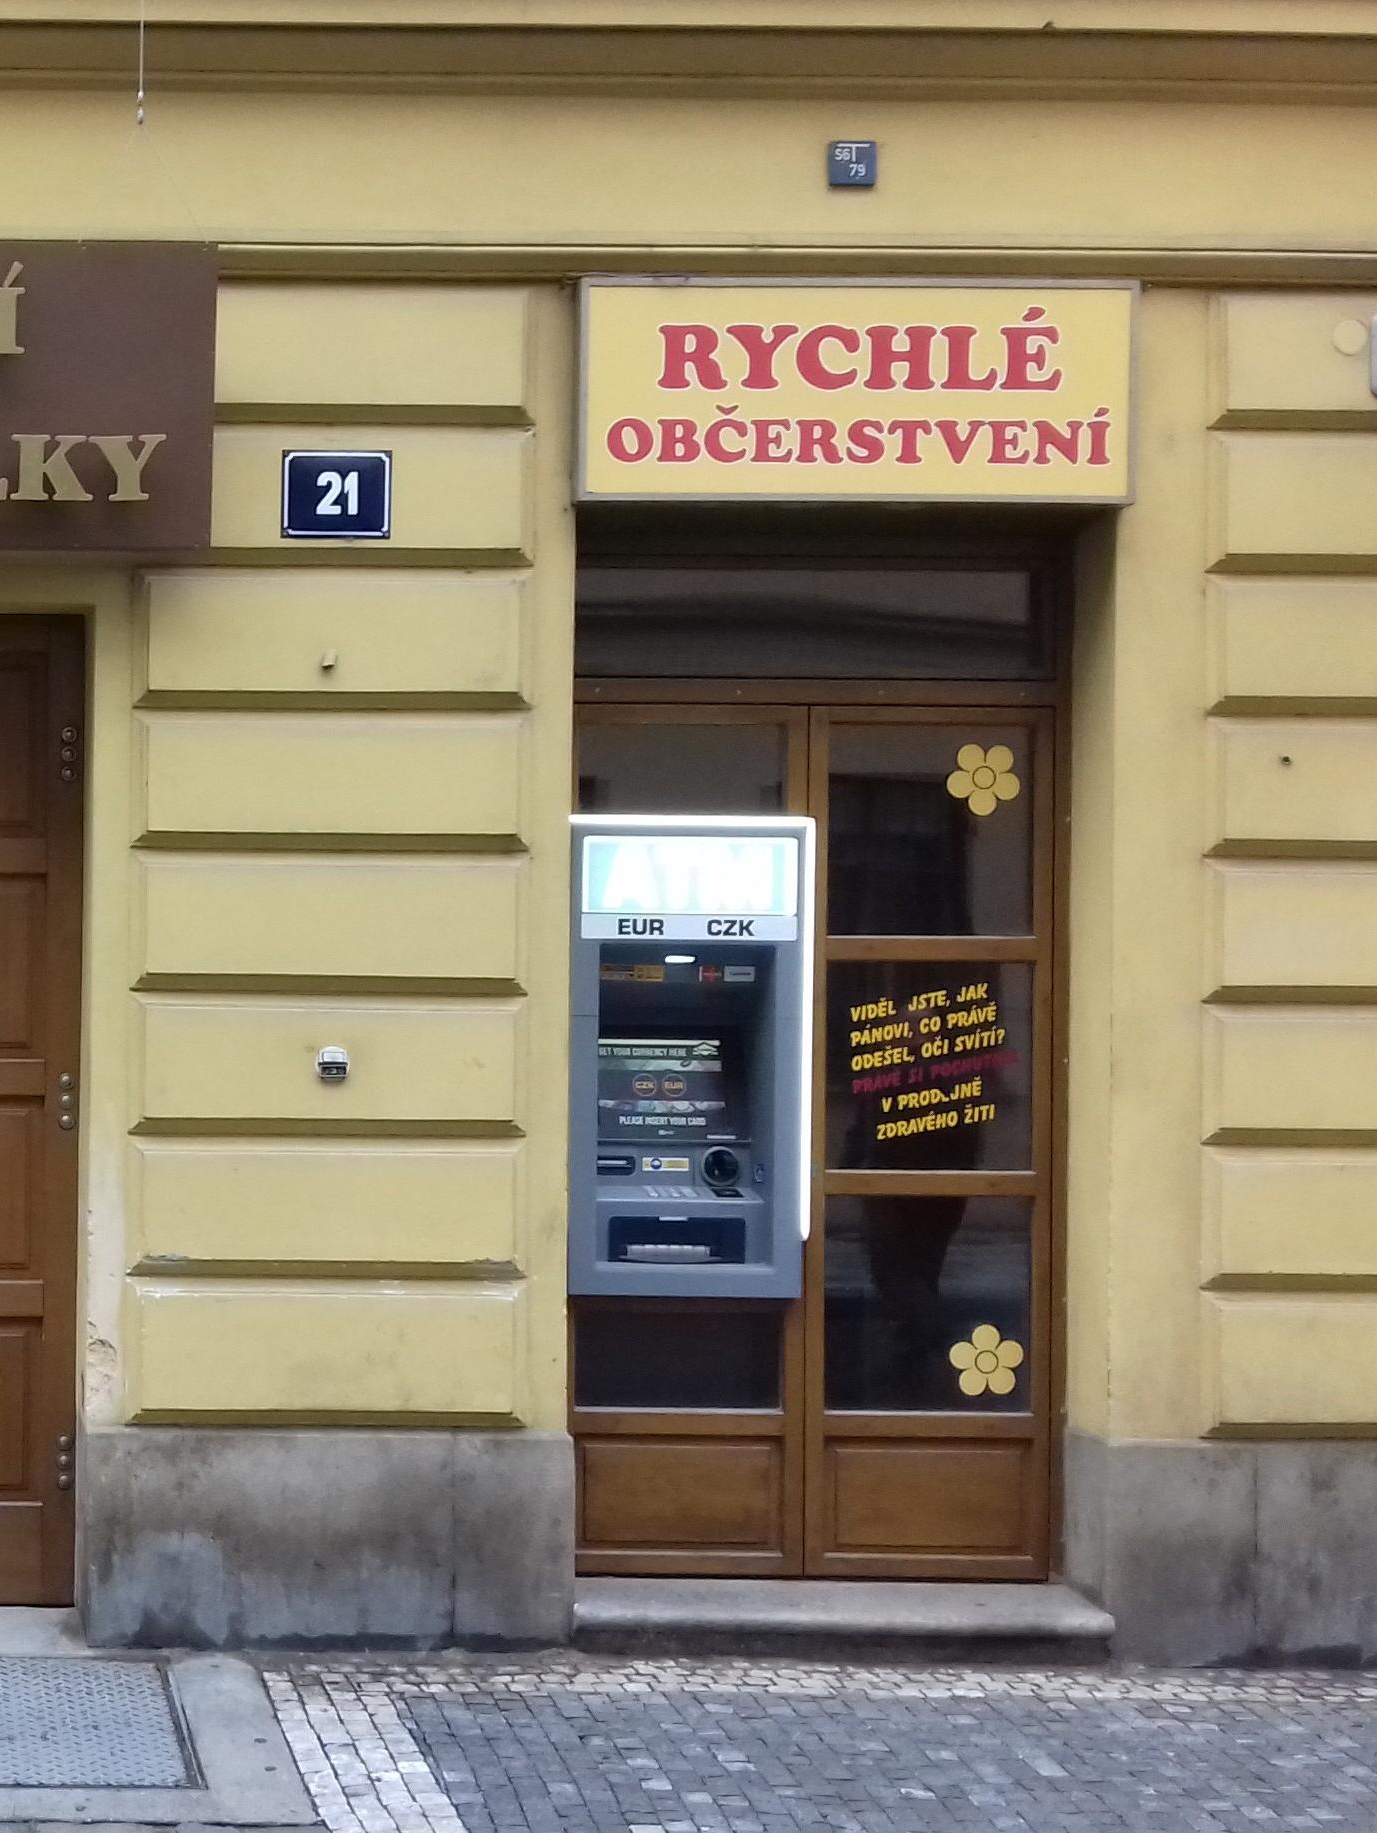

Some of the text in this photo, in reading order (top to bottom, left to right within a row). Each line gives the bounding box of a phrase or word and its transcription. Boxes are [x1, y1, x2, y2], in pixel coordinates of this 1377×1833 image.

[657, 305, 1063, 391] RYCHLÉ
[606, 404, 1112, 465] OBČERSTVENÍ
[315, 471, 359, 516] 21
[617, 918, 755, 937] EUR CZK
[908, 989, 951, 1012] JSTE,
[957, 982, 989, 1003] JAK
[849, 1001, 998, 1047] PÁNOVI, CO PRÁVĚ
[851, 1026, 1006, 1072] ODEŠEL, OČI SVÍTÍ?
[876, 1103, 996, 1140] ZDRAVÉHO ŽITI
[882, 1096, 893, 1113] V
